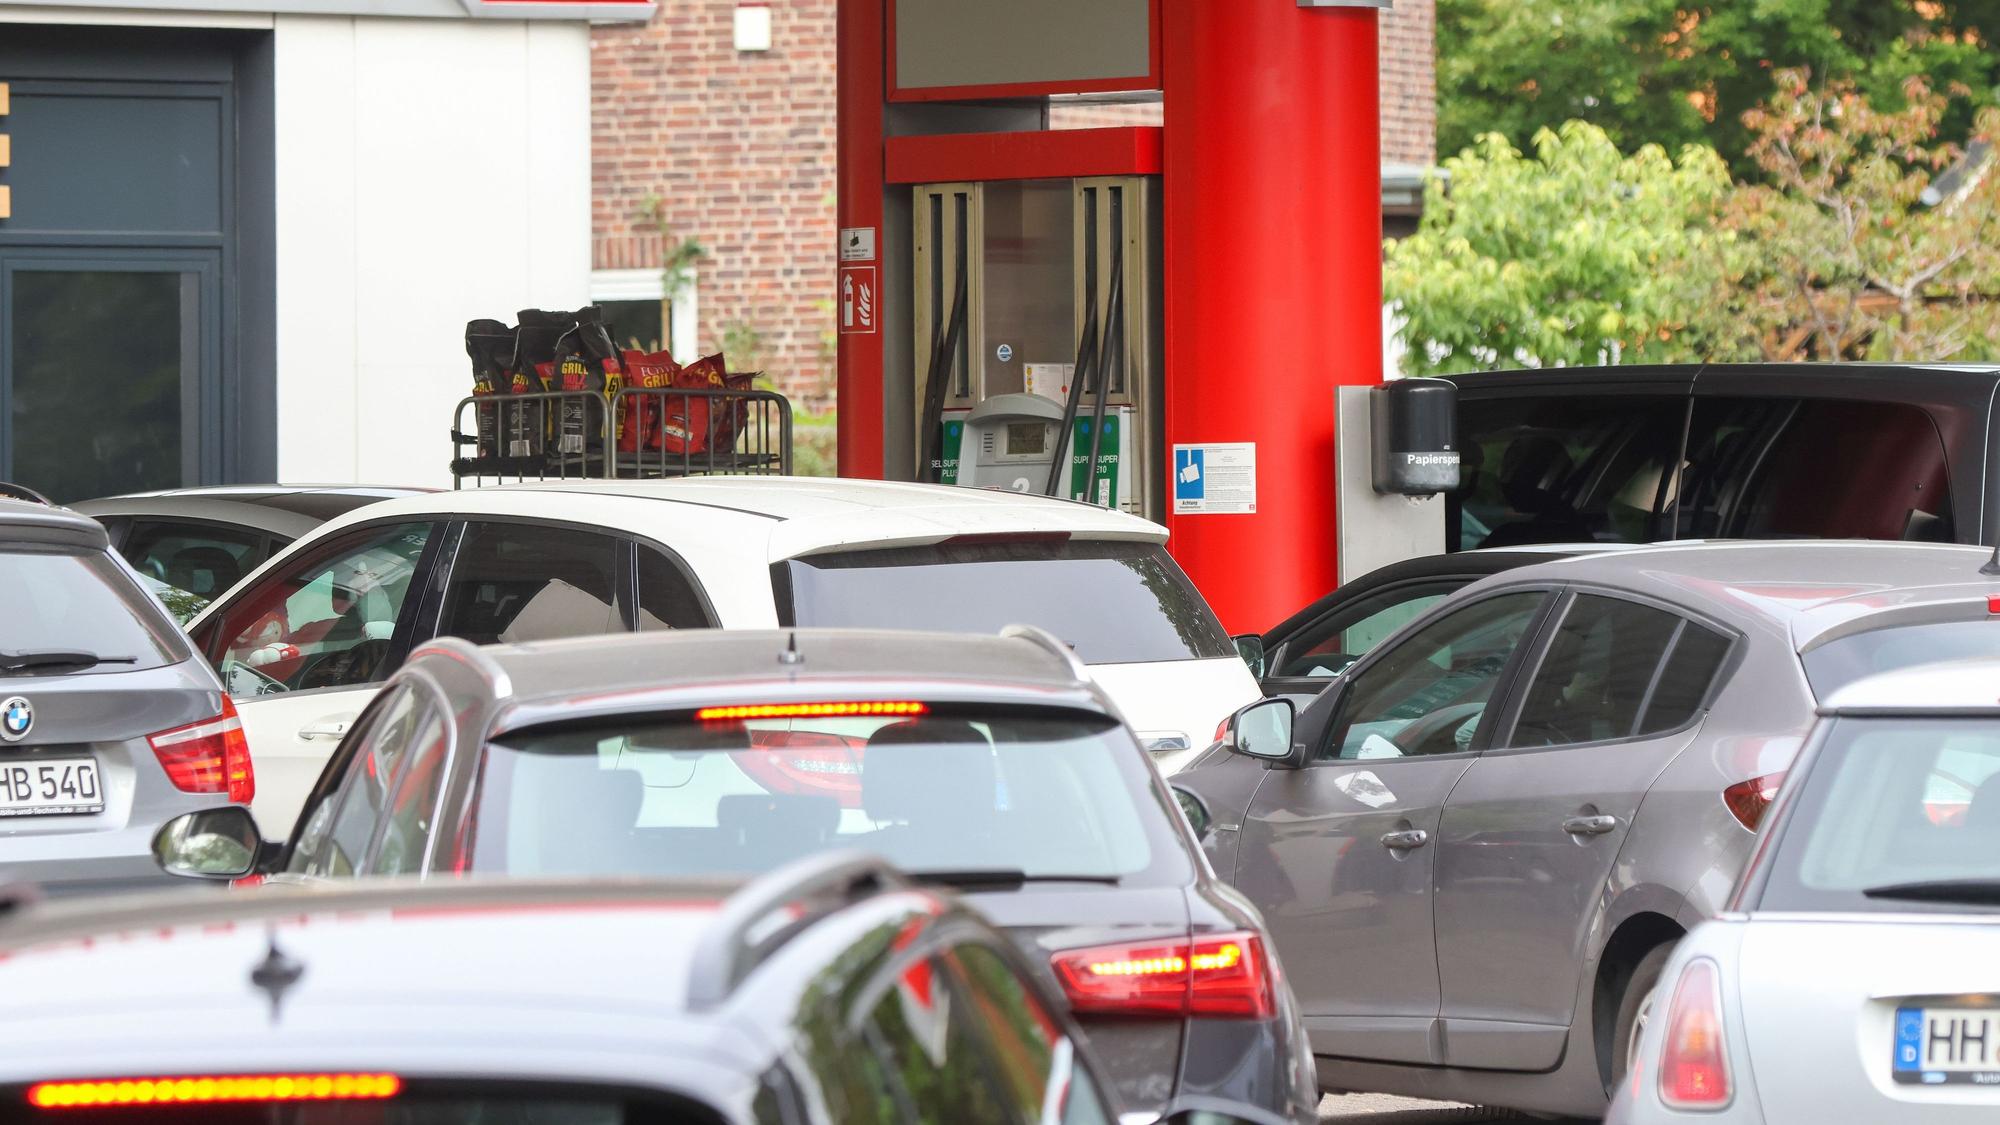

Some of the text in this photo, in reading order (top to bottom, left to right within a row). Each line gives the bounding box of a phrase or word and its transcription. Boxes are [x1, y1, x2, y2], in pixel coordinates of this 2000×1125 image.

[561, 361, 588, 375] GRILL
[1097, 454, 1119, 464] SUPER
[38, 766, 96, 799] 540
[1927, 1019, 1988, 1062] HH
[1901, 1045, 1917, 1062] D
